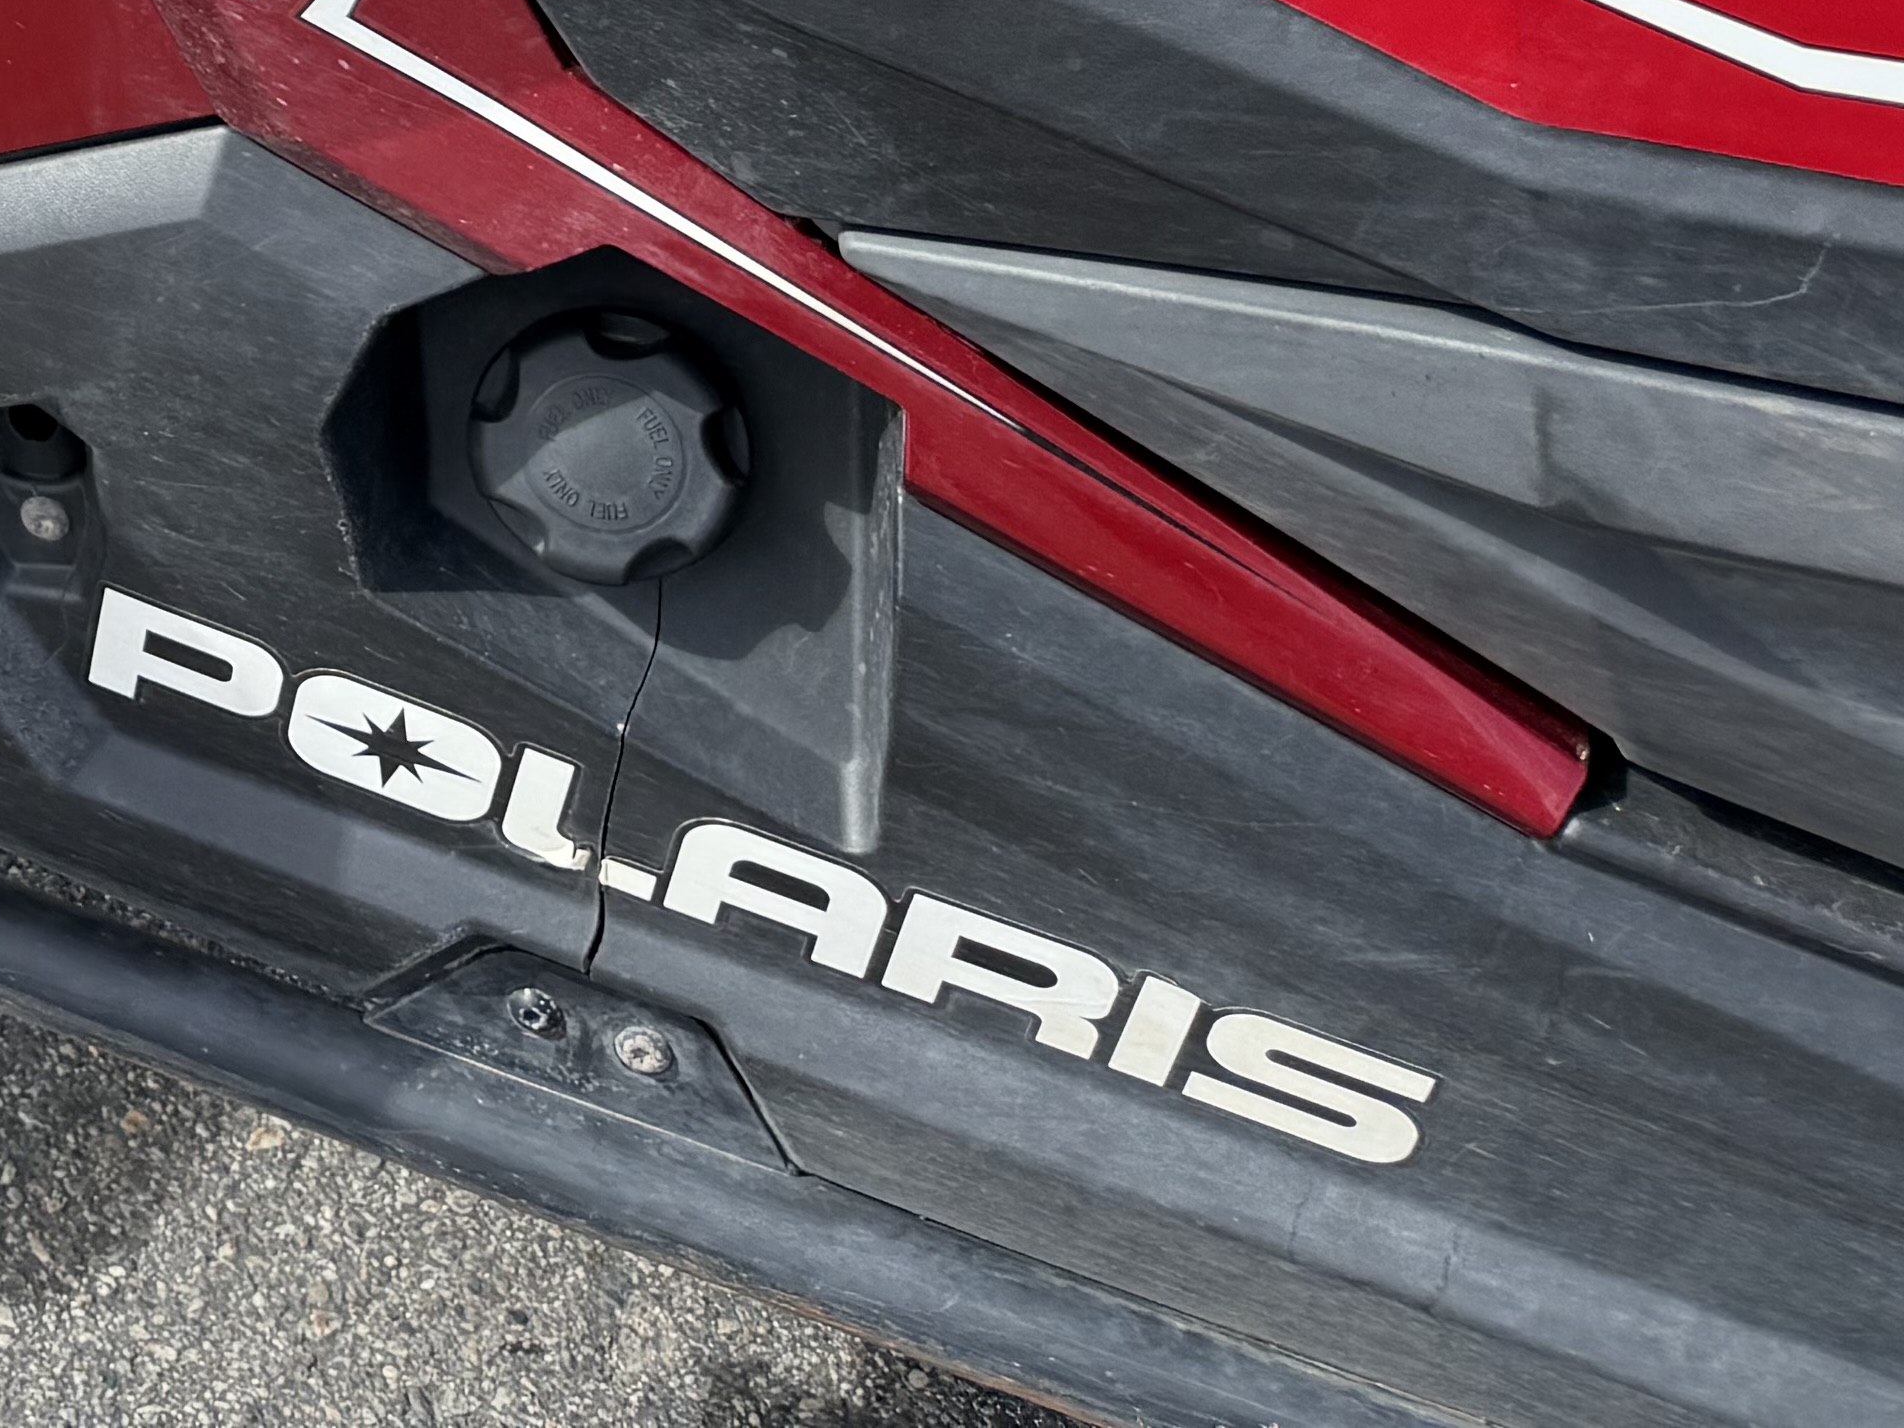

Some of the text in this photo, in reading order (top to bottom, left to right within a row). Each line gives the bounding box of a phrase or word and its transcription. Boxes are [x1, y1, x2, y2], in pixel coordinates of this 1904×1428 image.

[543, 467, 630, 522] FUEL ONLY
[635, 406, 675, 501] FUEL ONLY
[87, 584, 1442, 1166] POLARIS
